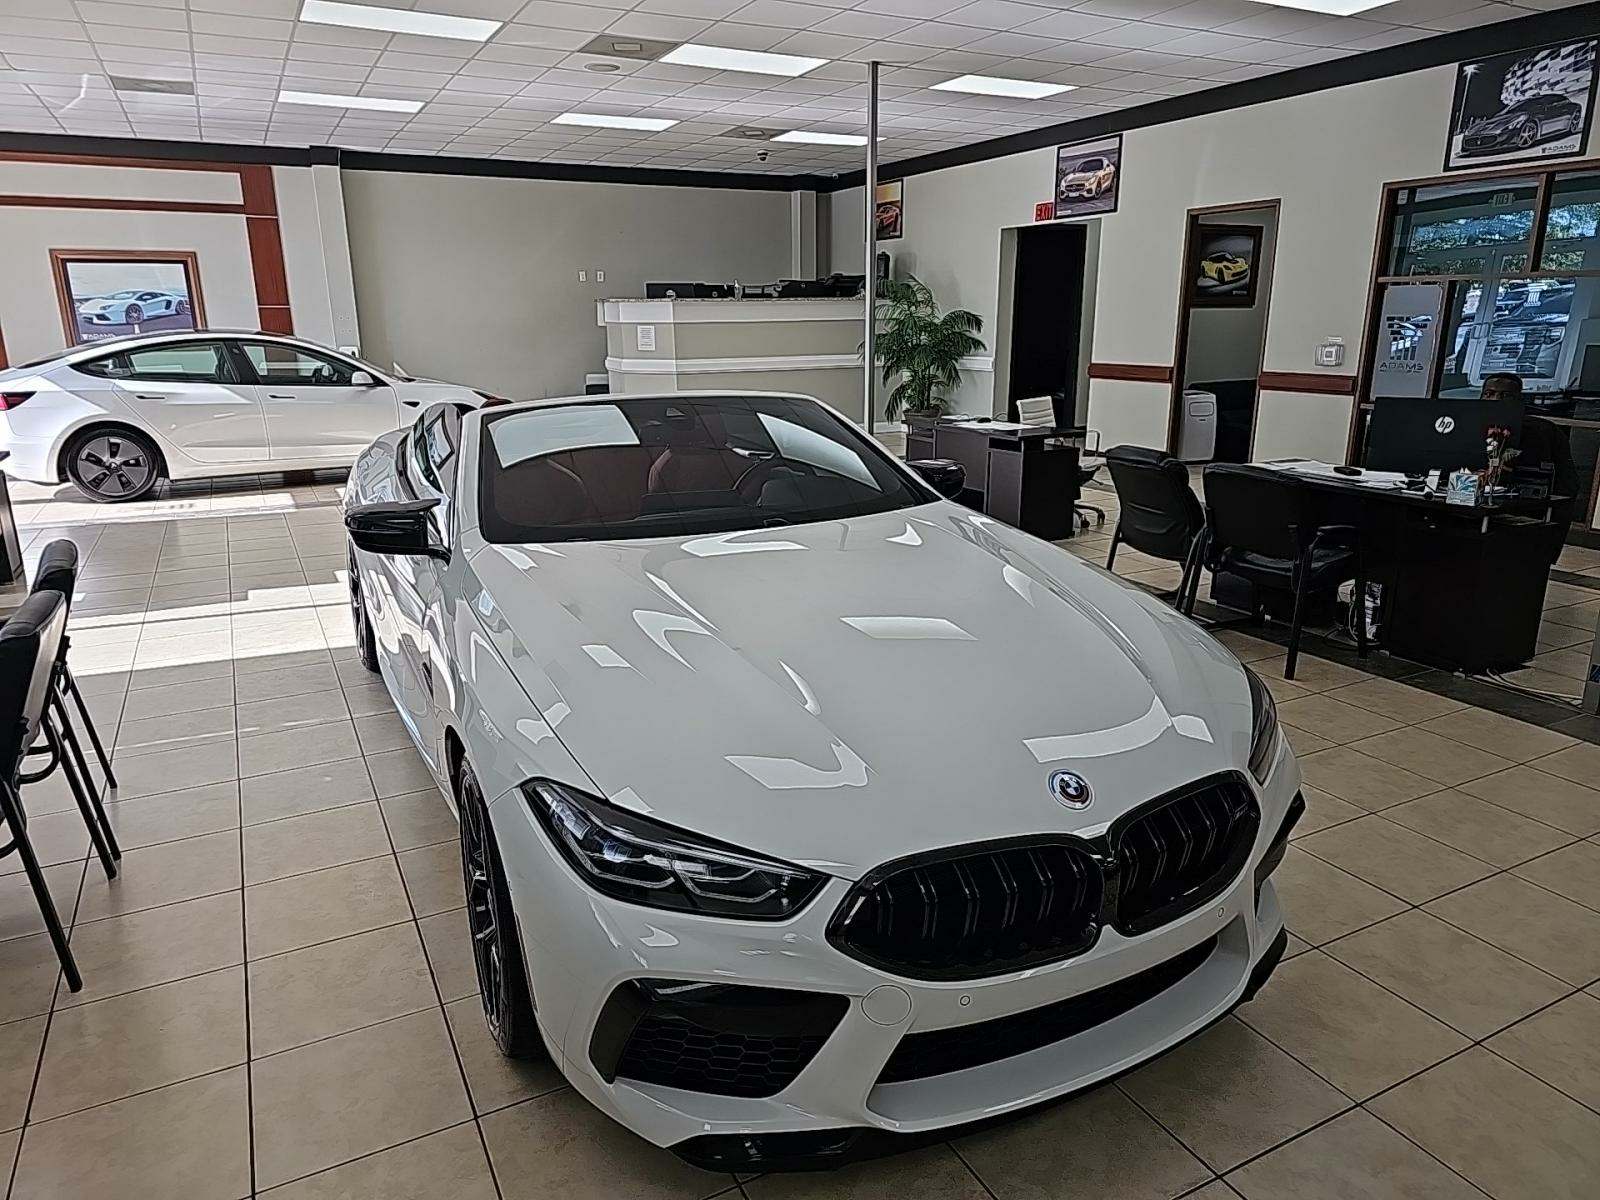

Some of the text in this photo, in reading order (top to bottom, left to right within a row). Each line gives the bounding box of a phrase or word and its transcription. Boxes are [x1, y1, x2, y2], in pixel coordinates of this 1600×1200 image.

[1037, 204, 1052, 220] EXIT
[1379, 362, 1424, 371] ADAMS
[1437, 416, 1453, 433] hp
